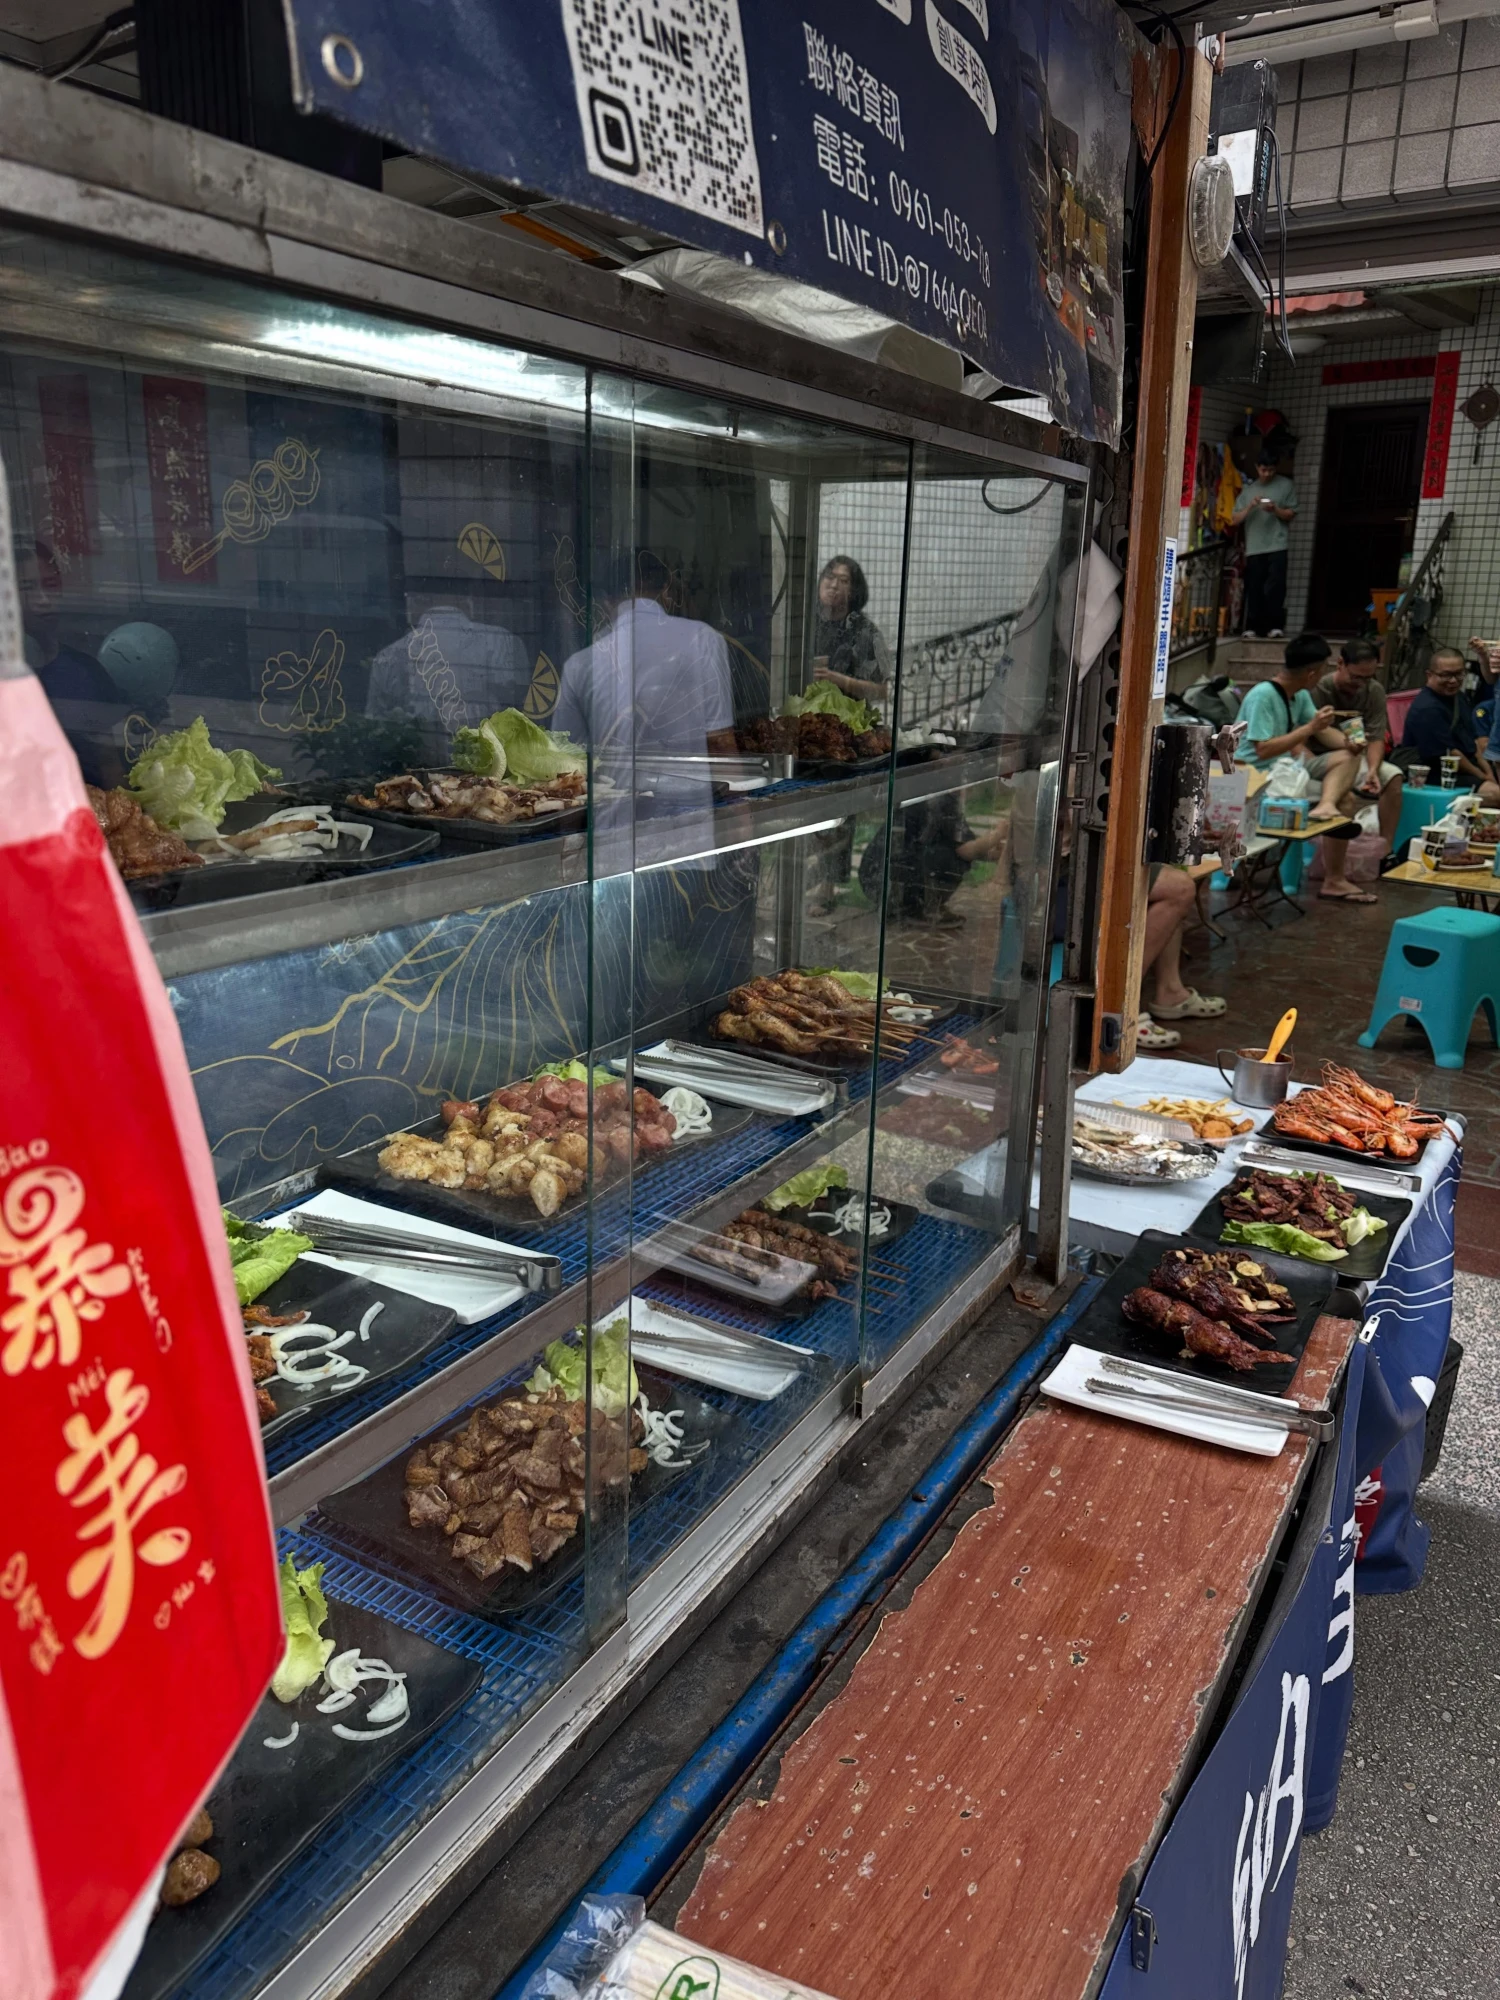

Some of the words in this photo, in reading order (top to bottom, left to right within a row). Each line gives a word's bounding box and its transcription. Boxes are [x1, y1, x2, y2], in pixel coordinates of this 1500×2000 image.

[637, 7, 693, 71] LINE
[802, 21, 905, 152] 聯絡資訊
[822, 208, 875, 277] LINE
[889, 170, 991, 288] 0961-053-718
